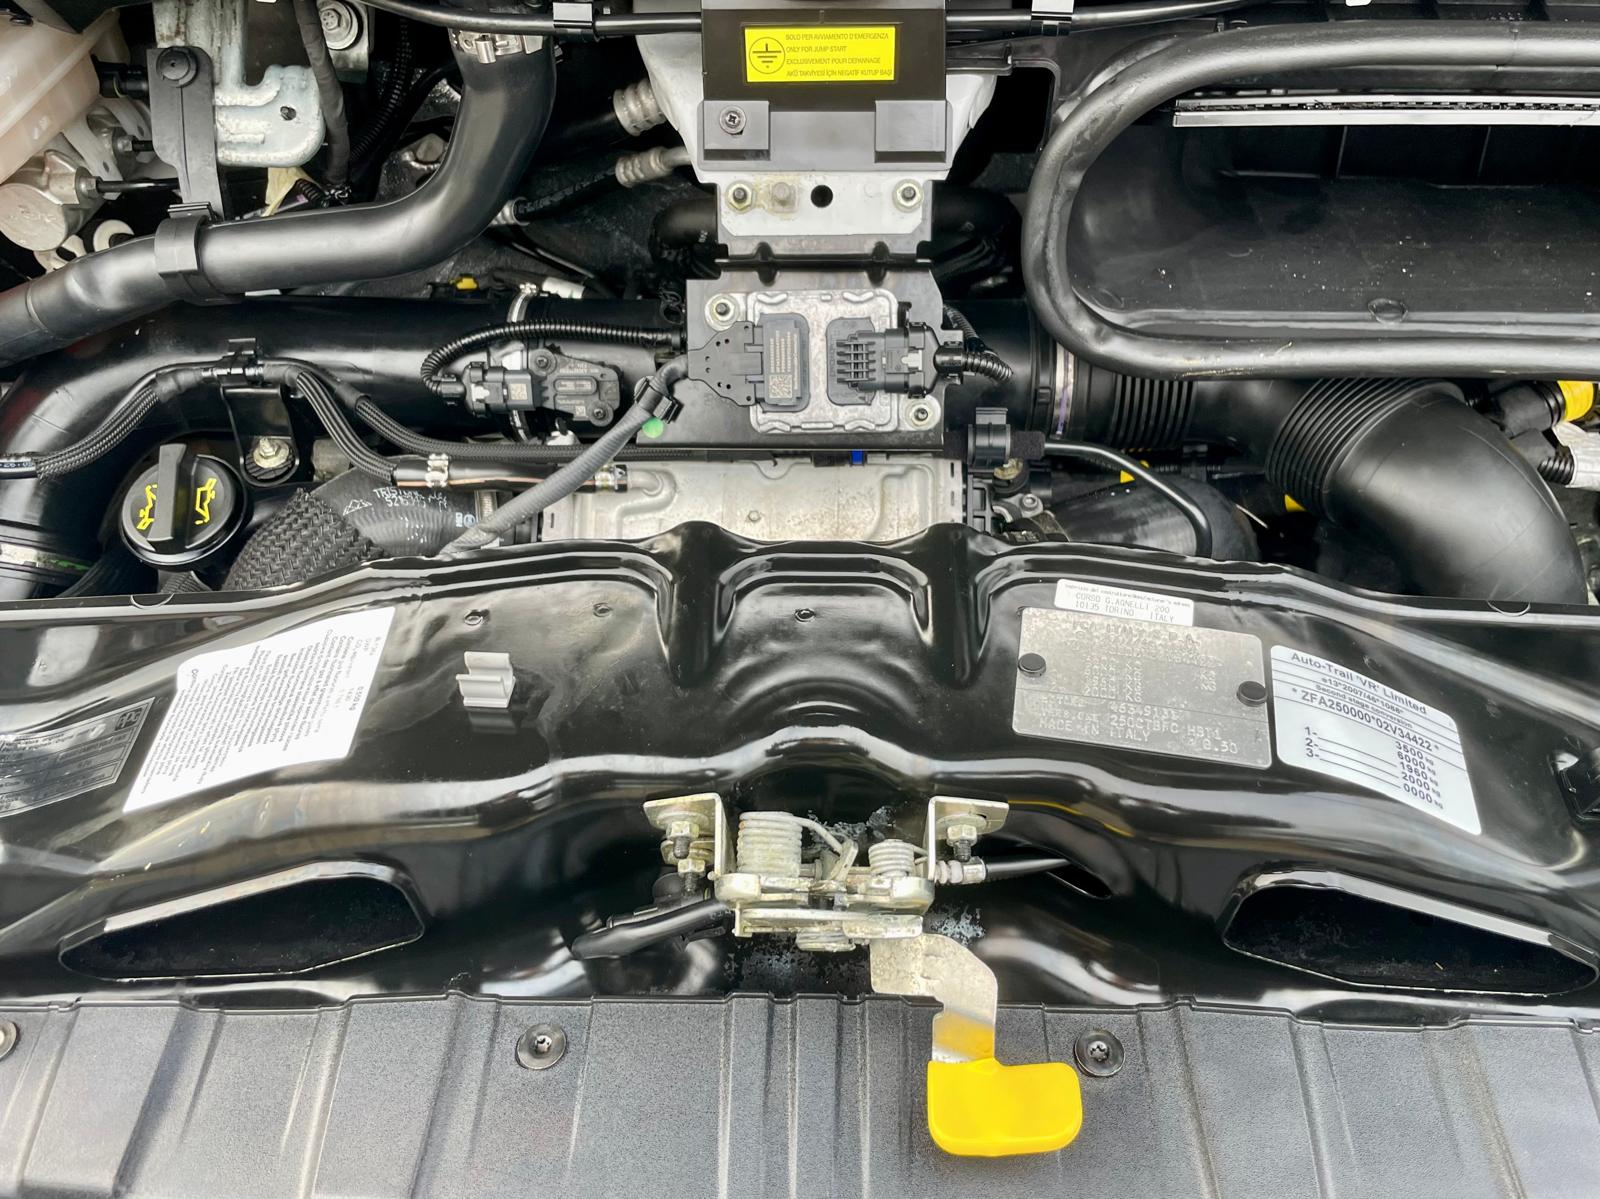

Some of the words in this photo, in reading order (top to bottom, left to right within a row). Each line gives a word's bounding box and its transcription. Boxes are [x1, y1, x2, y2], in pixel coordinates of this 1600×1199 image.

[1075, 593, 1101, 602] CORSO
[1105, 597, 1149, 610] G.AGNELLI
[1076, 601, 1099, 611] 10135
[1106, 605, 1135, 616] TORINO
[1150, 611, 1174, 623] ITALY
[1292, 652, 1353, 681] Auto-Trail
[1383, 688, 1426, 714] Limited
[1315, 684, 1346, 700] Second
[1348, 697, 1370, 710] stage
[1371, 705, 1413, 728] conversion
[1396, 741, 1424, 760] 3500
[1397, 751, 1425, 770] 6000
[1401, 772, 1430, 791] 2000
[1404, 784, 1432, 804] 0000
